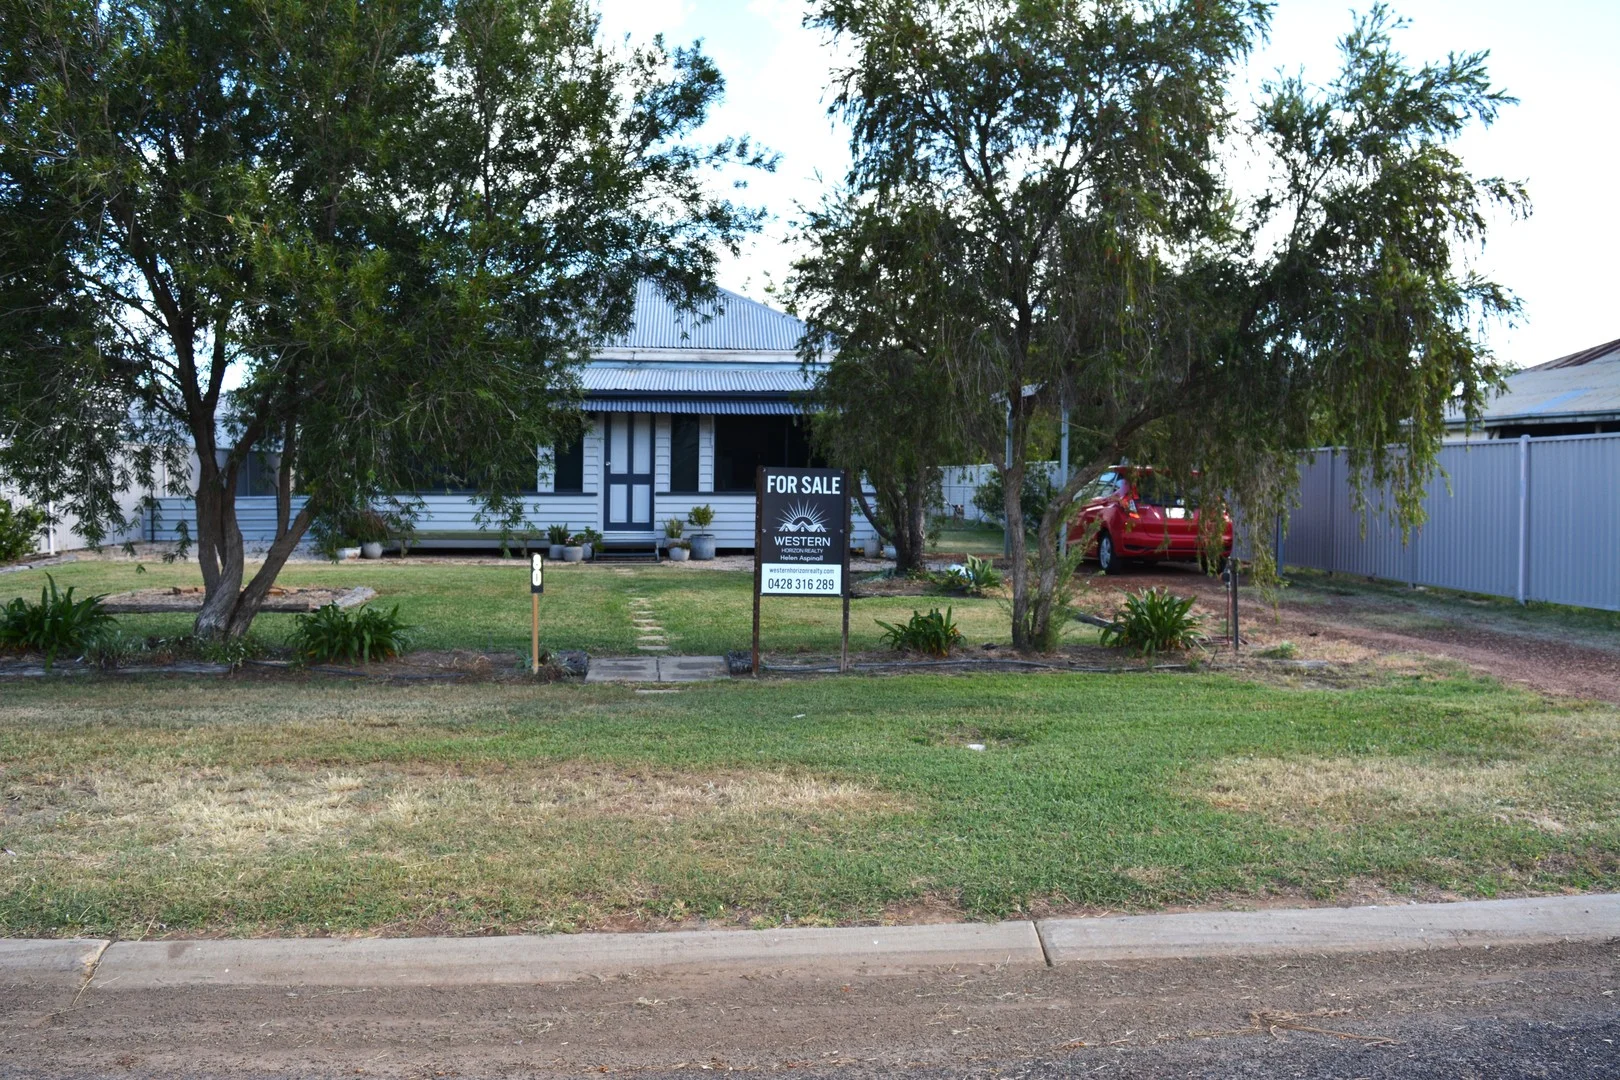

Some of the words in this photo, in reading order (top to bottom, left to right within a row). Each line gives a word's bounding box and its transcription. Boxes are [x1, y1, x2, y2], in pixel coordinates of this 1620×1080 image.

[767, 475, 798, 494] FOR
[801, 476, 841, 495] SALE
[774, 536, 831, 547] WESTERN
[769, 567, 835, 575] westernhorizonrealty.com
[768, 578, 793, 590] 0428
[795, 578, 814, 590] 316
[816, 579, 835, 590] 289
